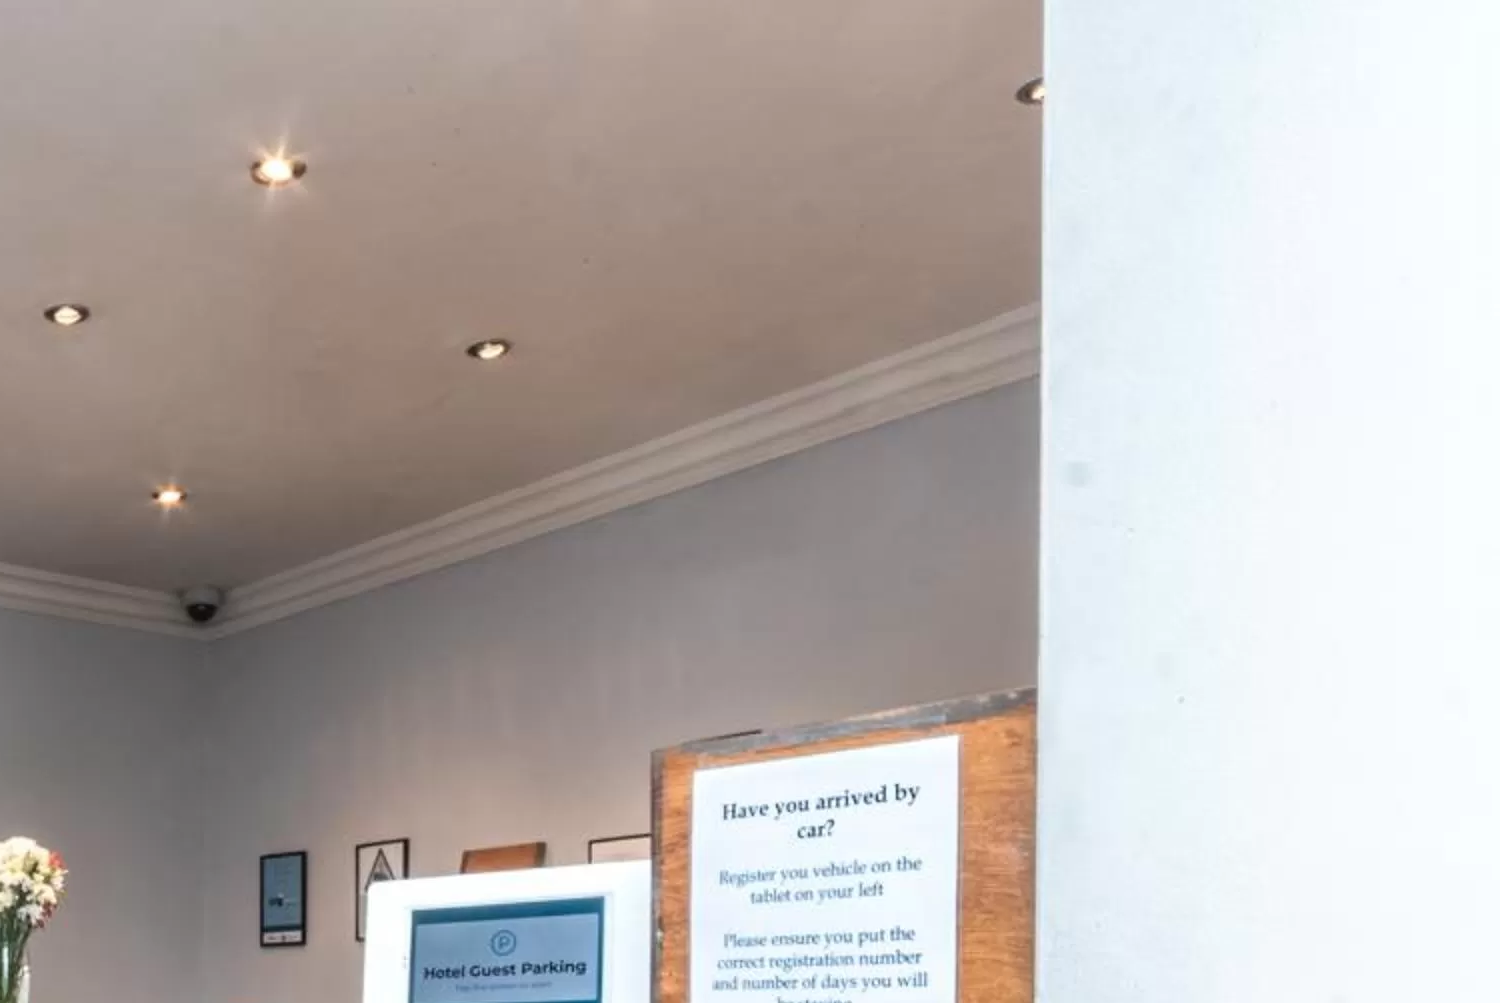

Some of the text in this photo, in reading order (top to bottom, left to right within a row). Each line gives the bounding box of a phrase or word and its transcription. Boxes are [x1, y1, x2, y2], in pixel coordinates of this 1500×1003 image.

[722, 782, 921, 821] Have you arrived by
[796, 818, 836, 840] car?
[719, 855, 923, 889] Register you vehicle on the
[750, 880, 884, 906] tablet on your left
[723, 925, 916, 950] Please ensure you put the
[423, 959, 587, 980] Hotel Guest Parking
[716, 948, 924, 974] correct registration number
[711, 970, 929, 994] and number of days you will
